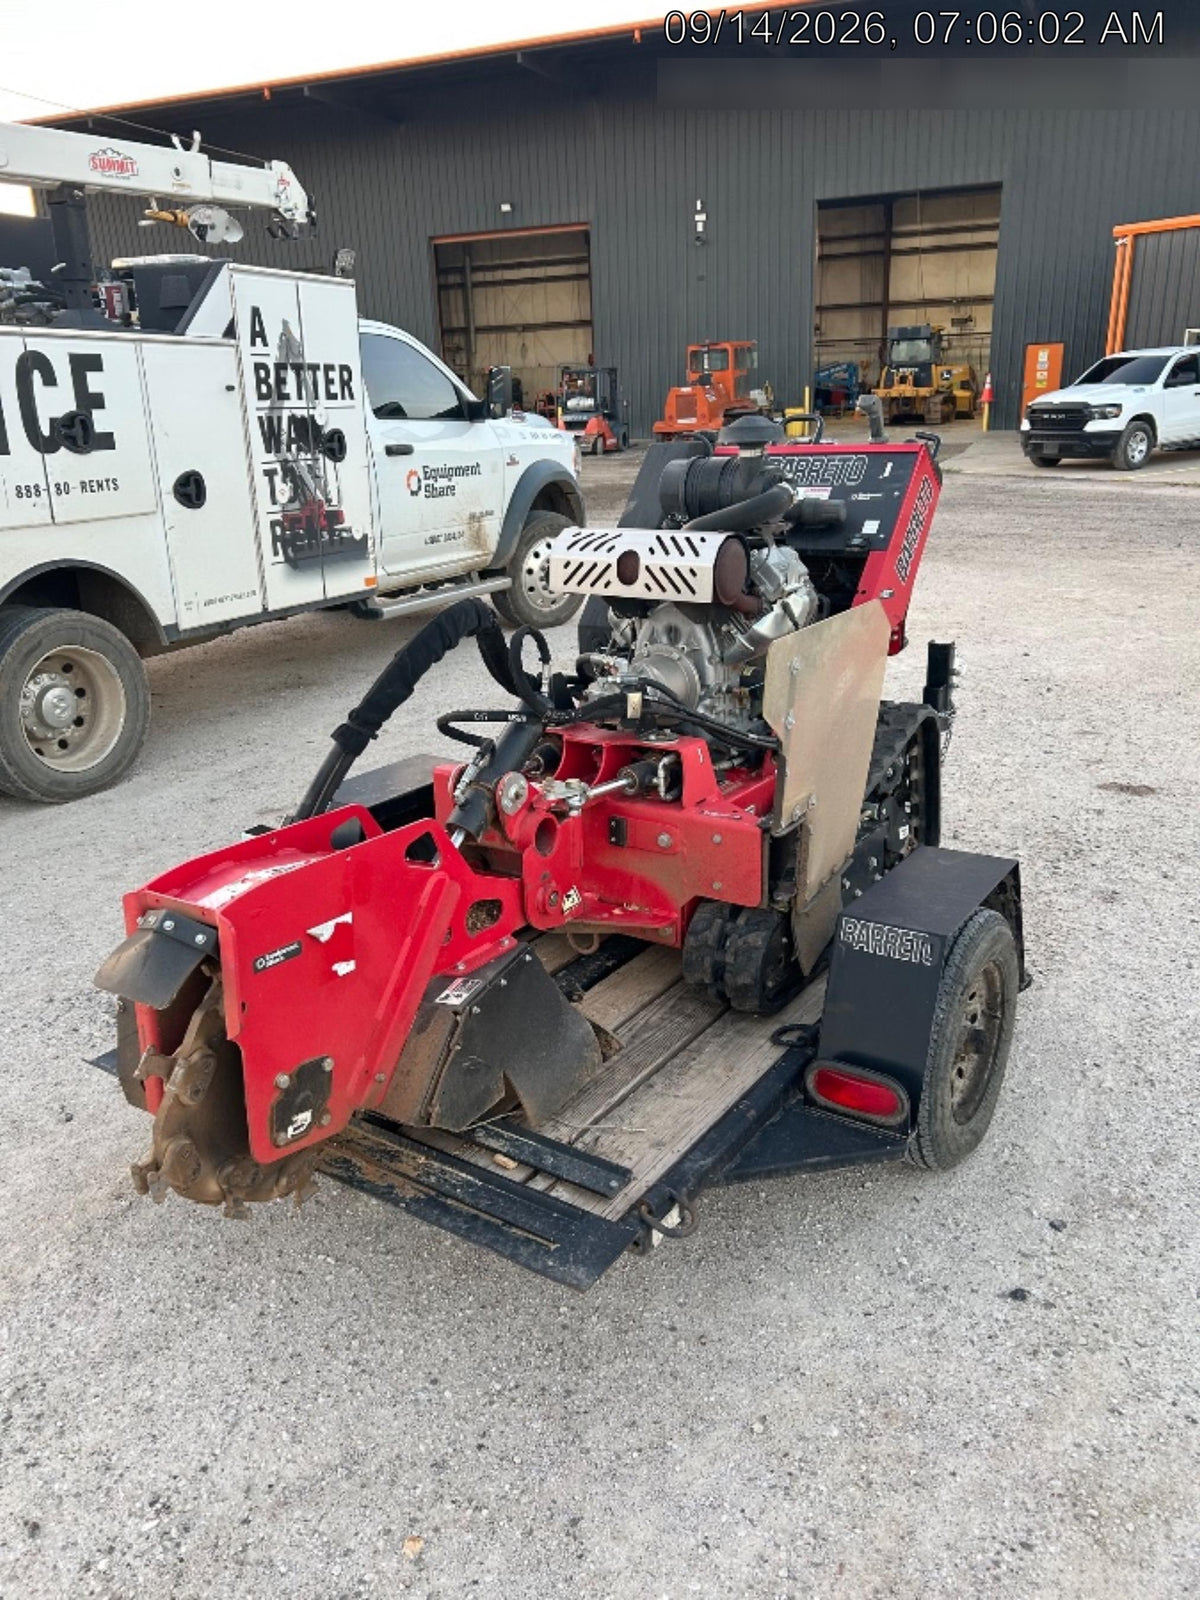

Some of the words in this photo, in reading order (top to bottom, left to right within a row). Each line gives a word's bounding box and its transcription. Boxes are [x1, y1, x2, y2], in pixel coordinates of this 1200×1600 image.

[91, 155, 135, 174] SUMMIT
[250, 305, 269, 347] A
[254, 361, 355, 401] BETTER
[0, 350, 116, 456] CE
[257, 414, 323, 454] WA
[422, 461, 482, 482] Equipment
[424, 483, 456, 499] Share
